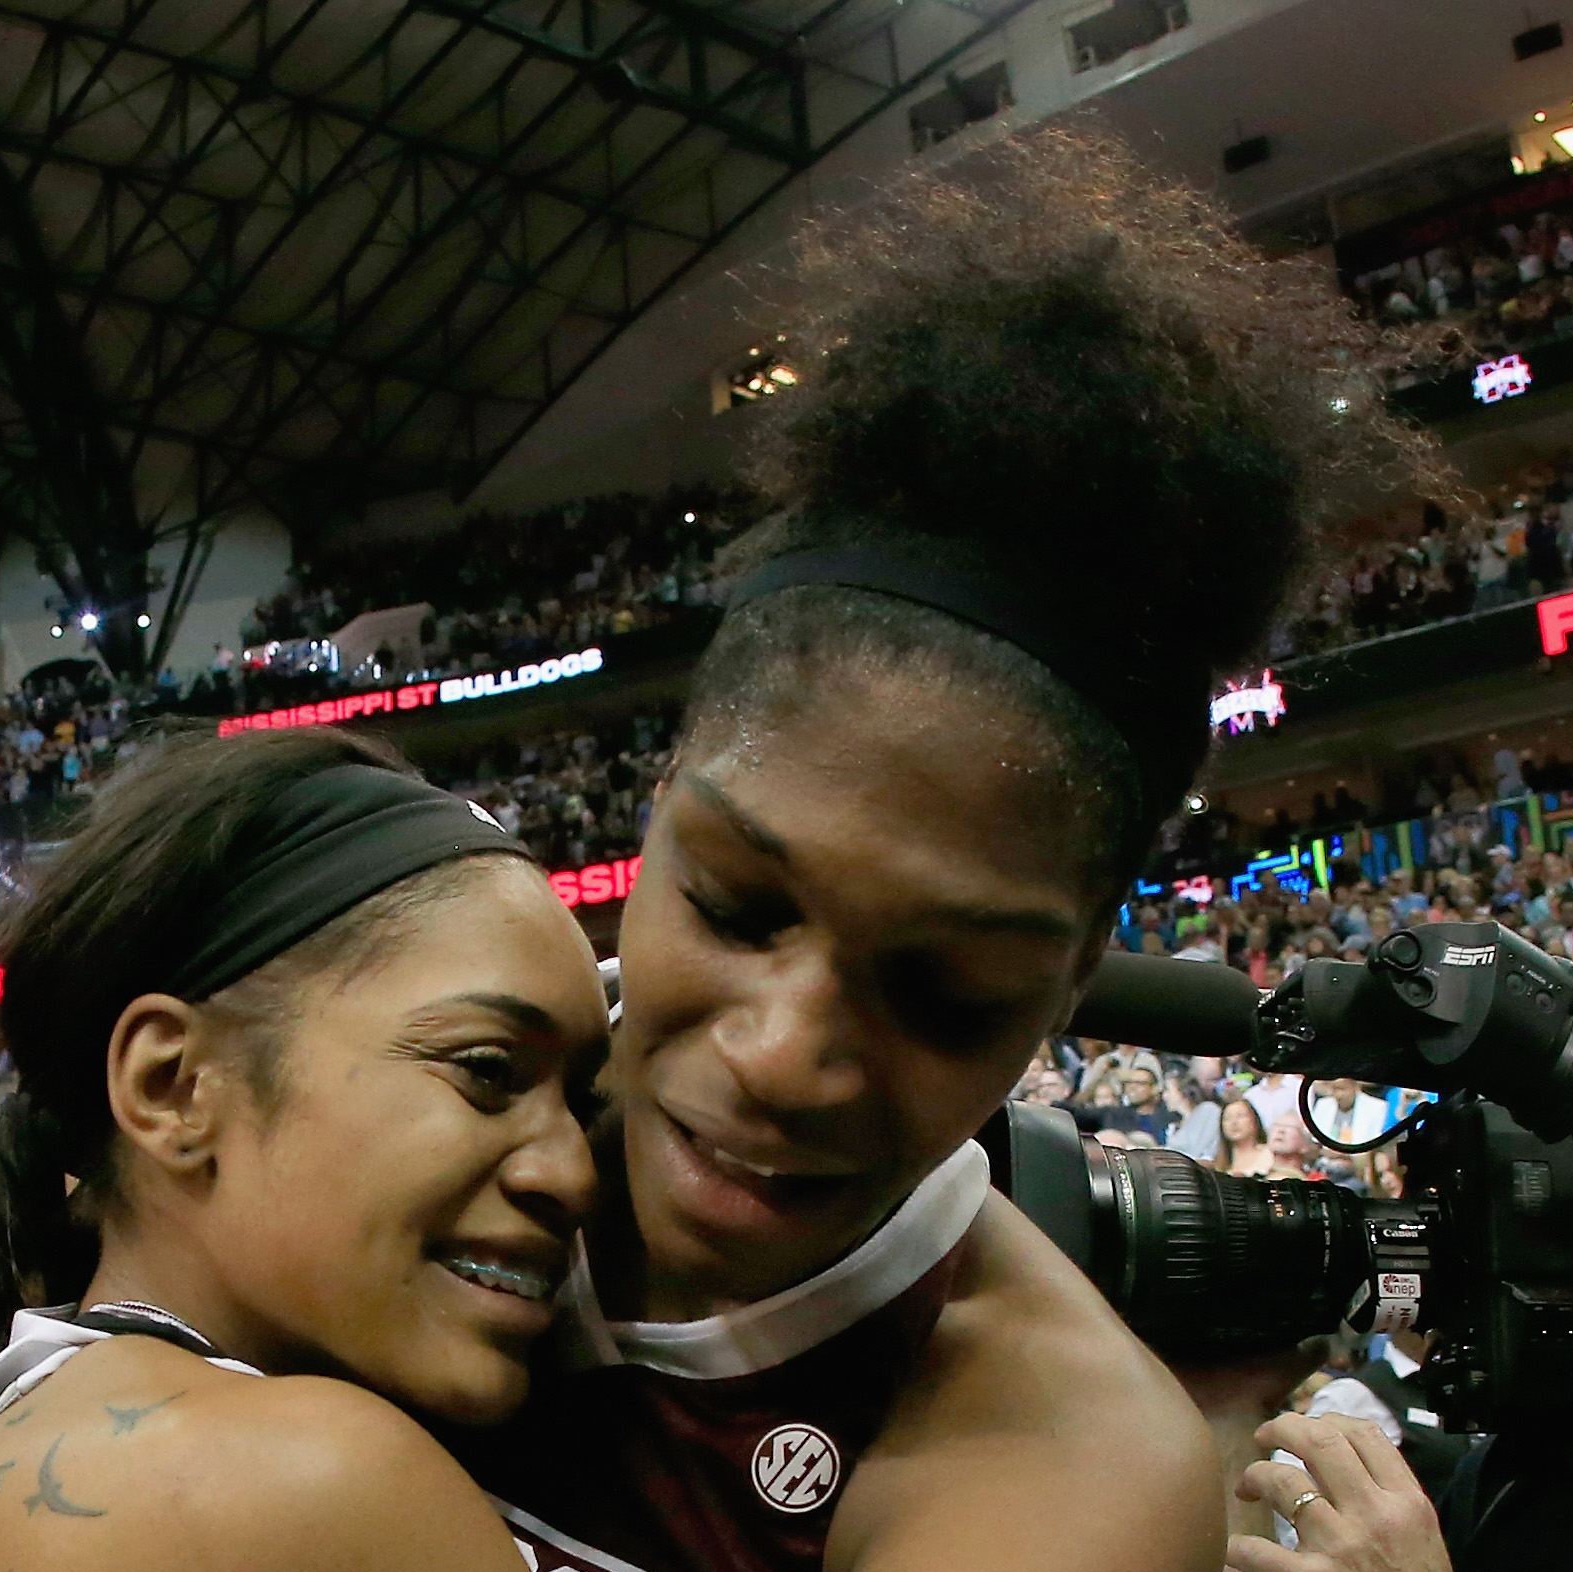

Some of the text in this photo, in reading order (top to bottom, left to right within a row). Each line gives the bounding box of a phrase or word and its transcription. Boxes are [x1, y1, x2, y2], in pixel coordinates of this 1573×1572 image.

[397, 683, 437, 711] ST
[440, 647, 603, 703] BULLDOGS
[1441, 946, 1496, 966] ESPN
[1383, 1229, 1419, 1238] Canon
[1394, 1284, 1416, 1296] nep
[759, 1430, 833, 1506] SEC
